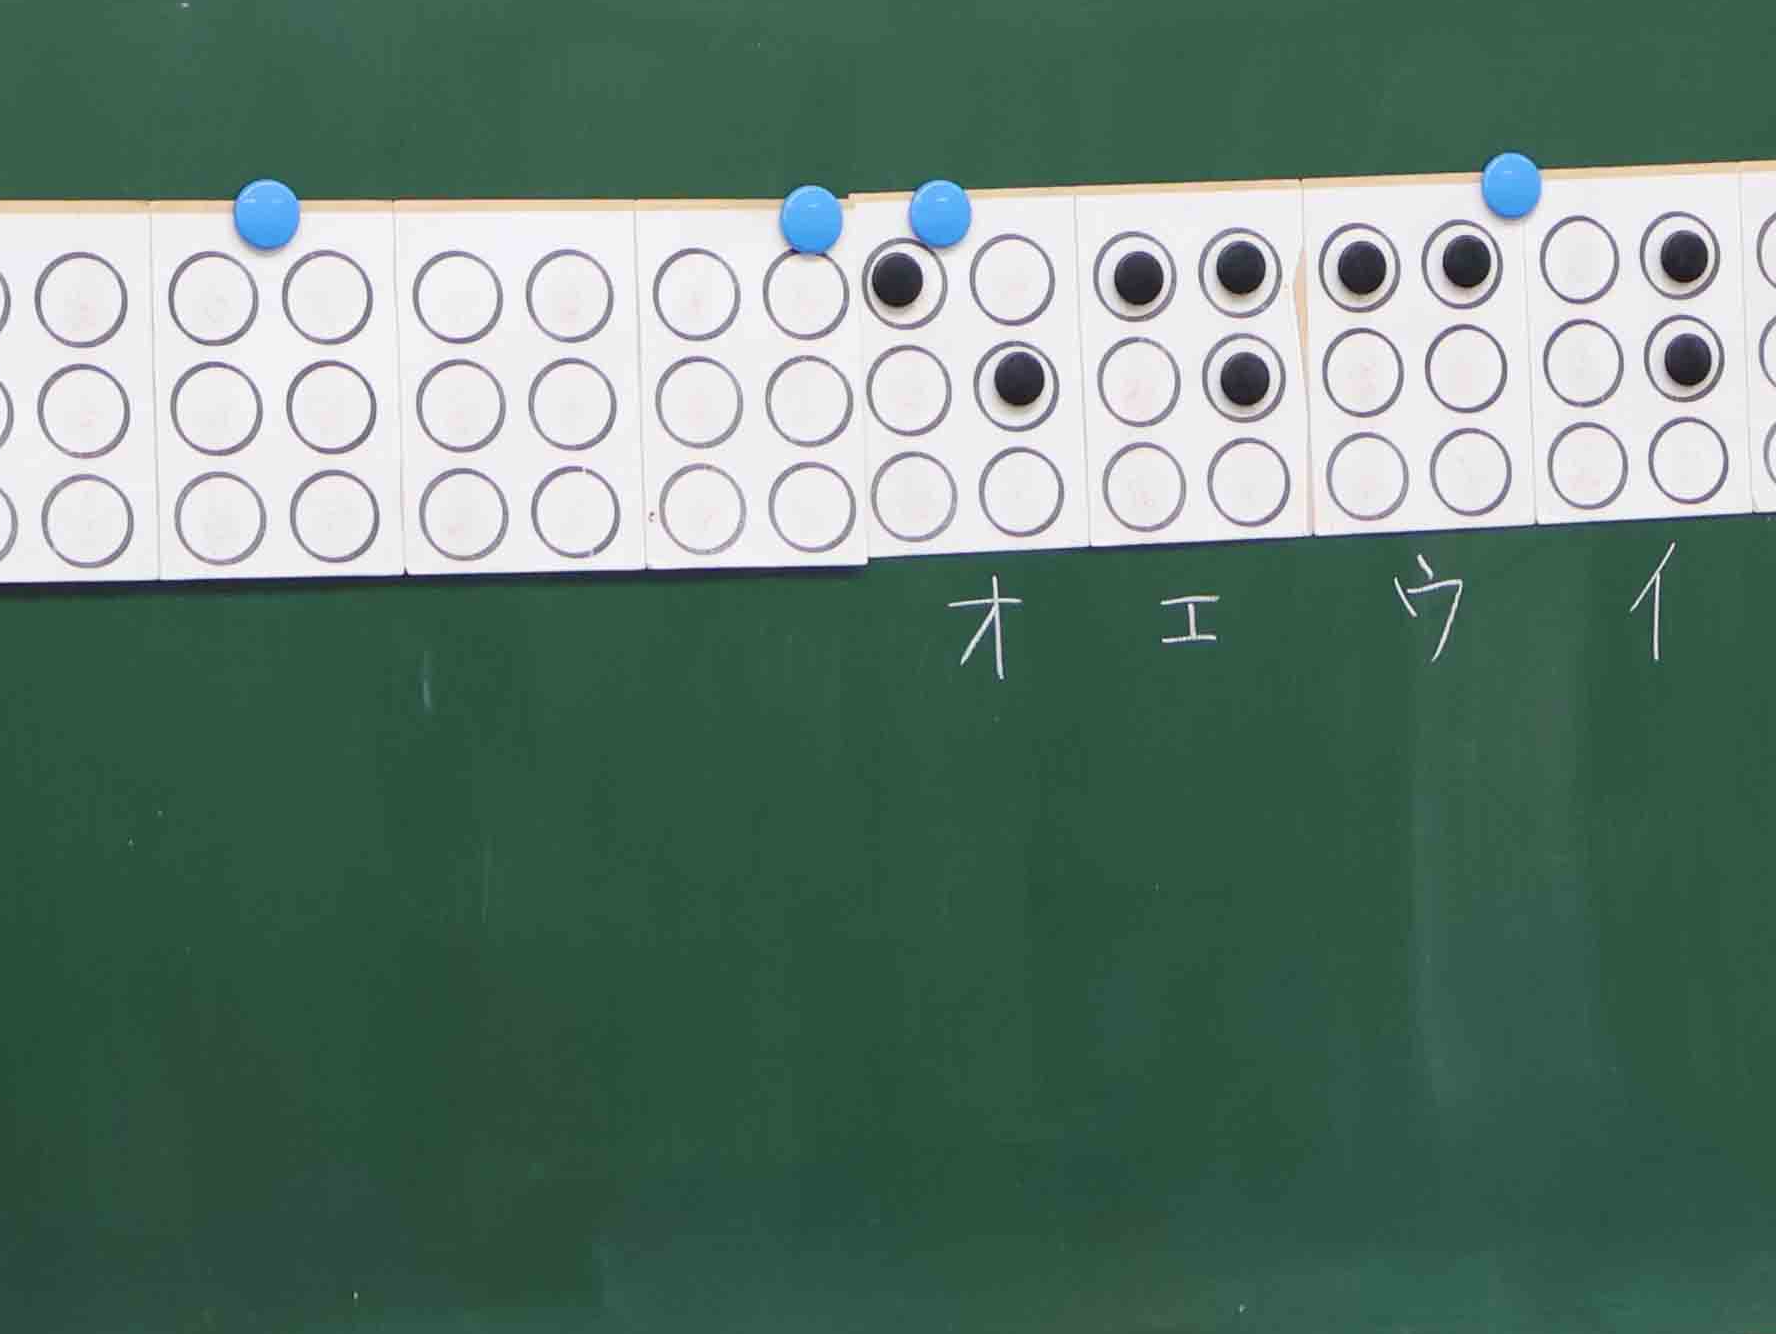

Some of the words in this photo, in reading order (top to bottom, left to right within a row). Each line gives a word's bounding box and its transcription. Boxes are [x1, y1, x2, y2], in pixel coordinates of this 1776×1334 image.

[948, 574, 1023, 679] オ
[1161, 595, 1220, 644] エ
[1394, 554, 1464, 664] ウ
[1630, 542, 1677, 662] イ
